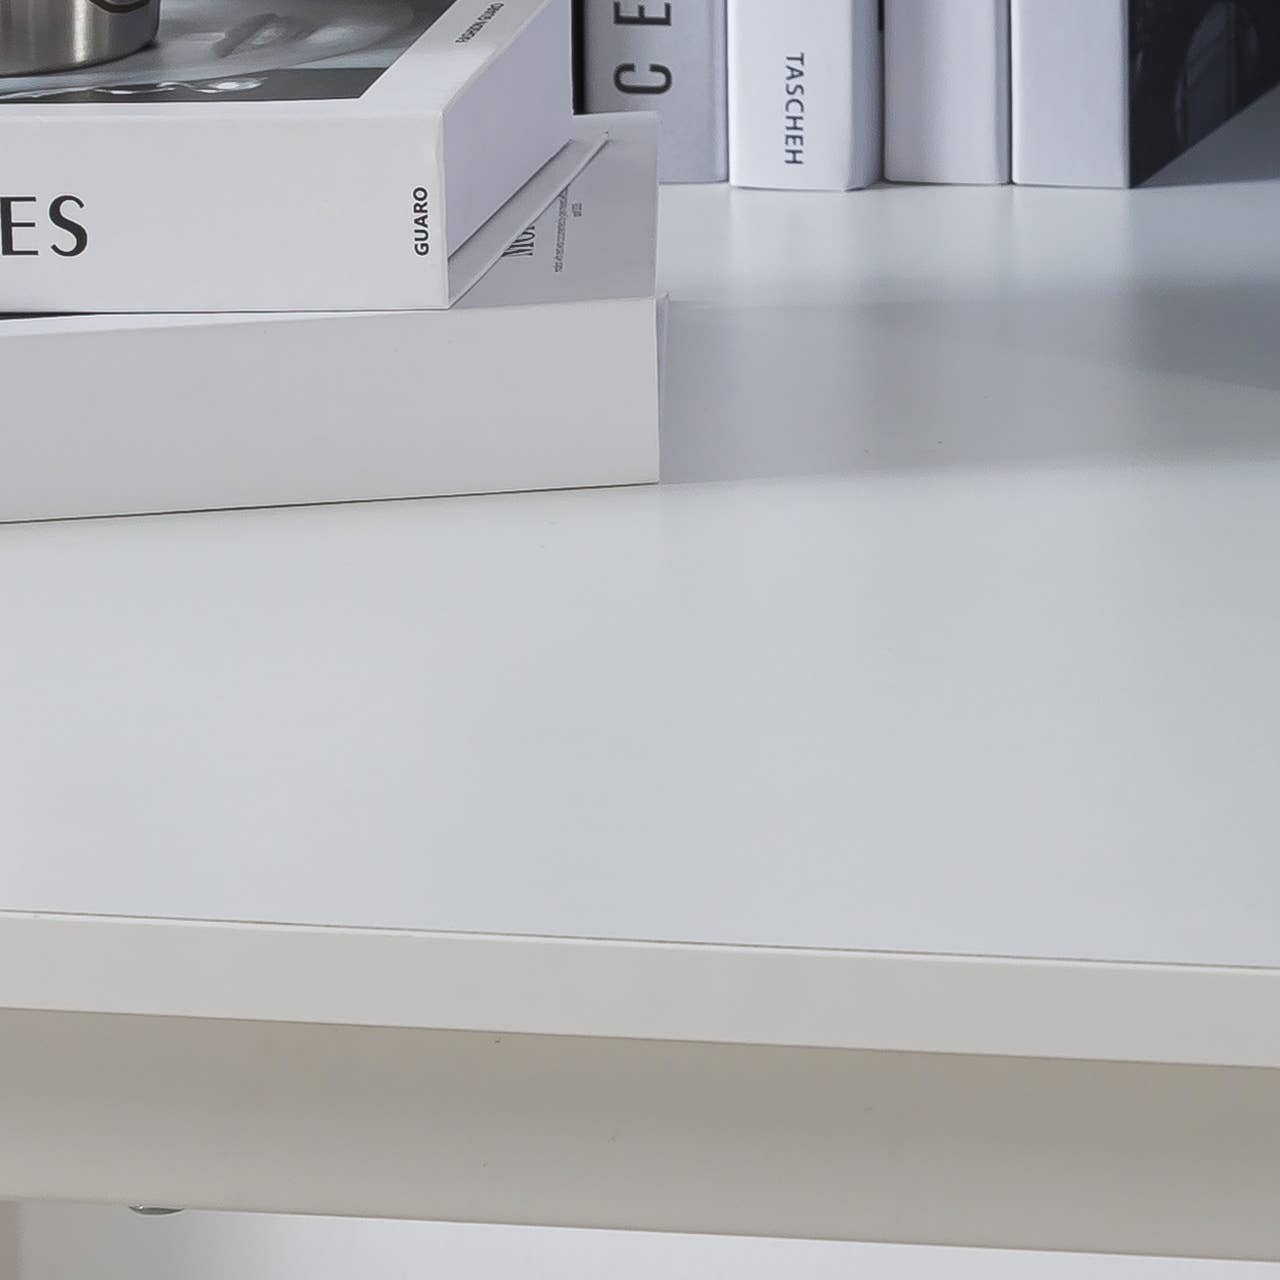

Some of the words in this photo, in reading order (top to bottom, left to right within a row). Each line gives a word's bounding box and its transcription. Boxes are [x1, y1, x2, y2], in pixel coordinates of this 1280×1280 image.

[785, 52, 805, 165] TASCHEH
[0, 195, 88, 257] ES
[414, 186, 429, 256] GUARO
